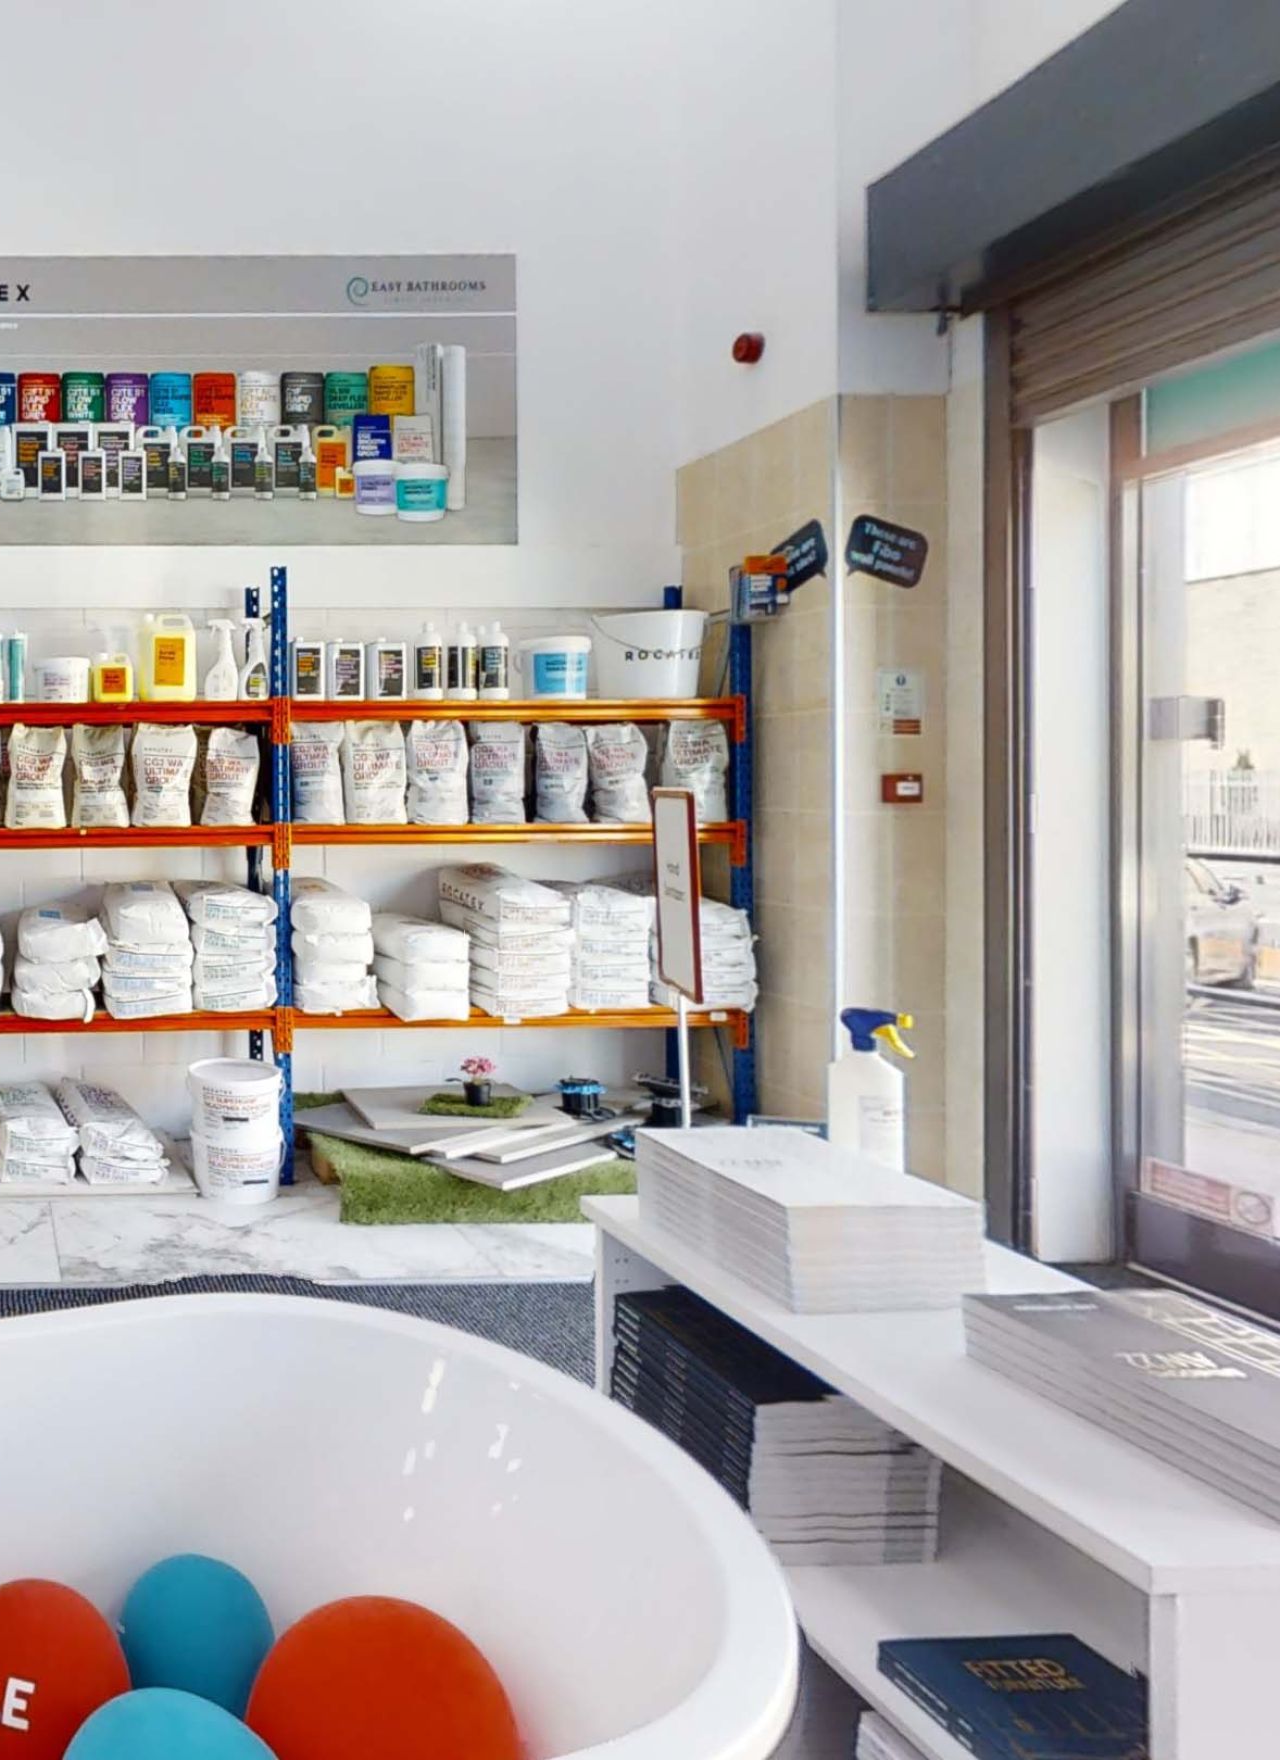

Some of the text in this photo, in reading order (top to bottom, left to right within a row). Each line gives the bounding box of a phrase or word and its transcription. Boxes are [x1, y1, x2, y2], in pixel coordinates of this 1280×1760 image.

[371, 280, 487, 292] EASY BATHROOMS
[962, 1659, 1068, 1678] FITTED
